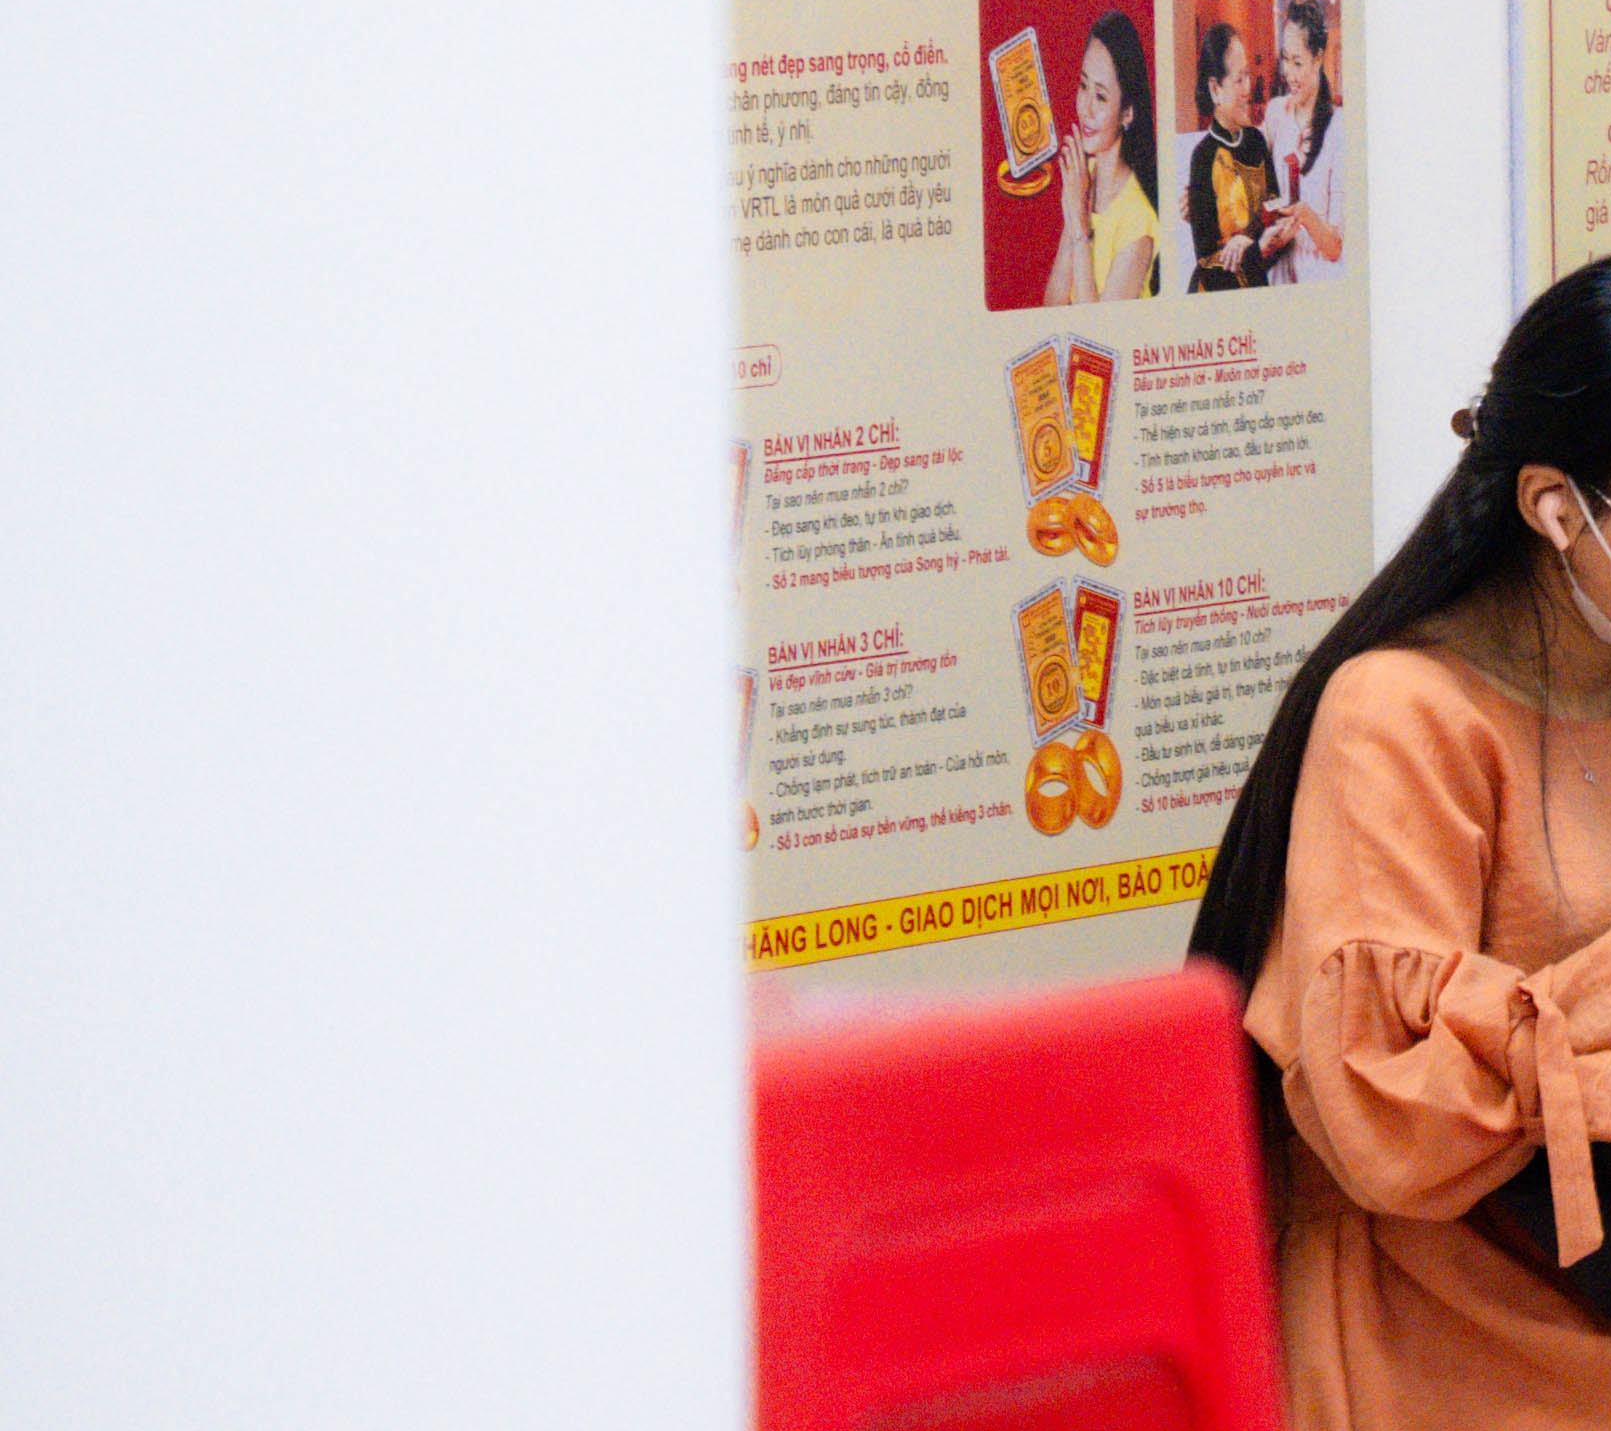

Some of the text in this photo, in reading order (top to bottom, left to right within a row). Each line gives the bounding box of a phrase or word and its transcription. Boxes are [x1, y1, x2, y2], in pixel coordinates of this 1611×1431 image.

[1217, 339, 1225, 356] 5
[816, 863, 1162, 950] LONG GIAO DỊCH MỌI NƠI, BẢO
